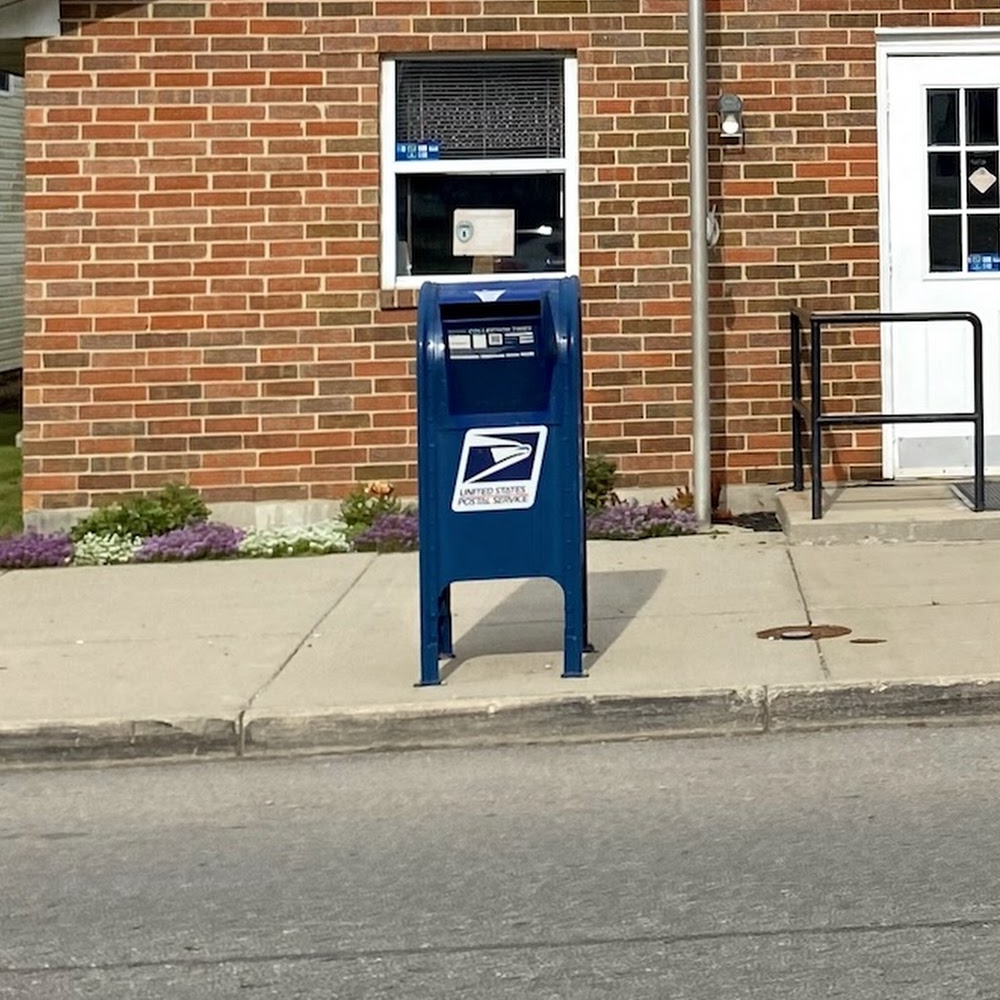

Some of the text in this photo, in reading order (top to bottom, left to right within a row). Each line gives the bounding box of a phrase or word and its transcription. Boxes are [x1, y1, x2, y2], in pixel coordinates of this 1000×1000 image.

[460, 485, 526, 497] UNITED STATES
[493, 495, 528, 504] SERVICE
